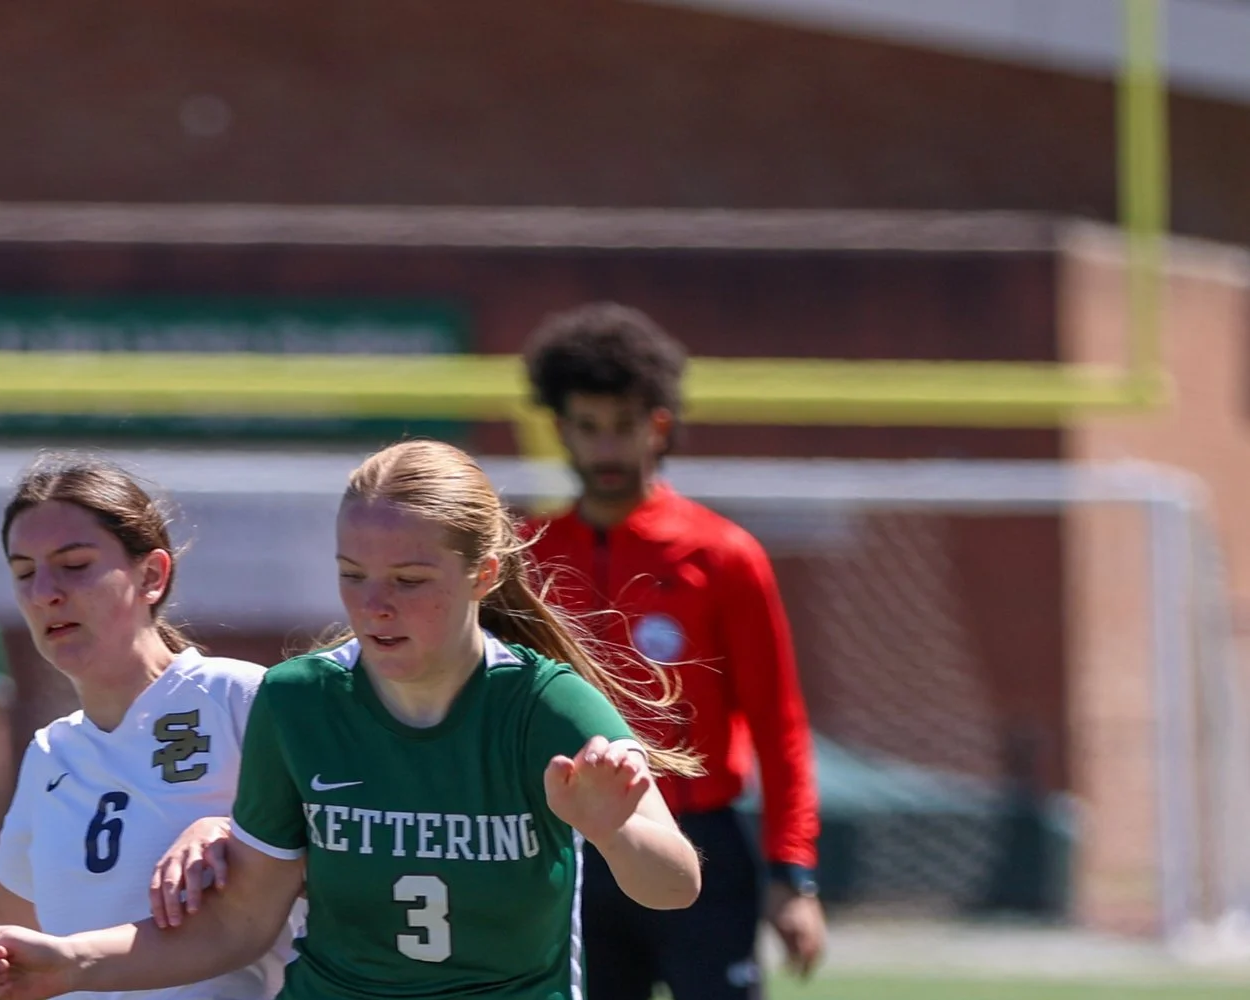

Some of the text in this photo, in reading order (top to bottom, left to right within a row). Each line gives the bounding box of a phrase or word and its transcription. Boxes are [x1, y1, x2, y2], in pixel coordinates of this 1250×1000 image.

[152, 709, 211, 784] SC
[85, 791, 130, 874] 6
[302, 802, 541, 862] KETTERING
[392, 874, 452, 963] 3
